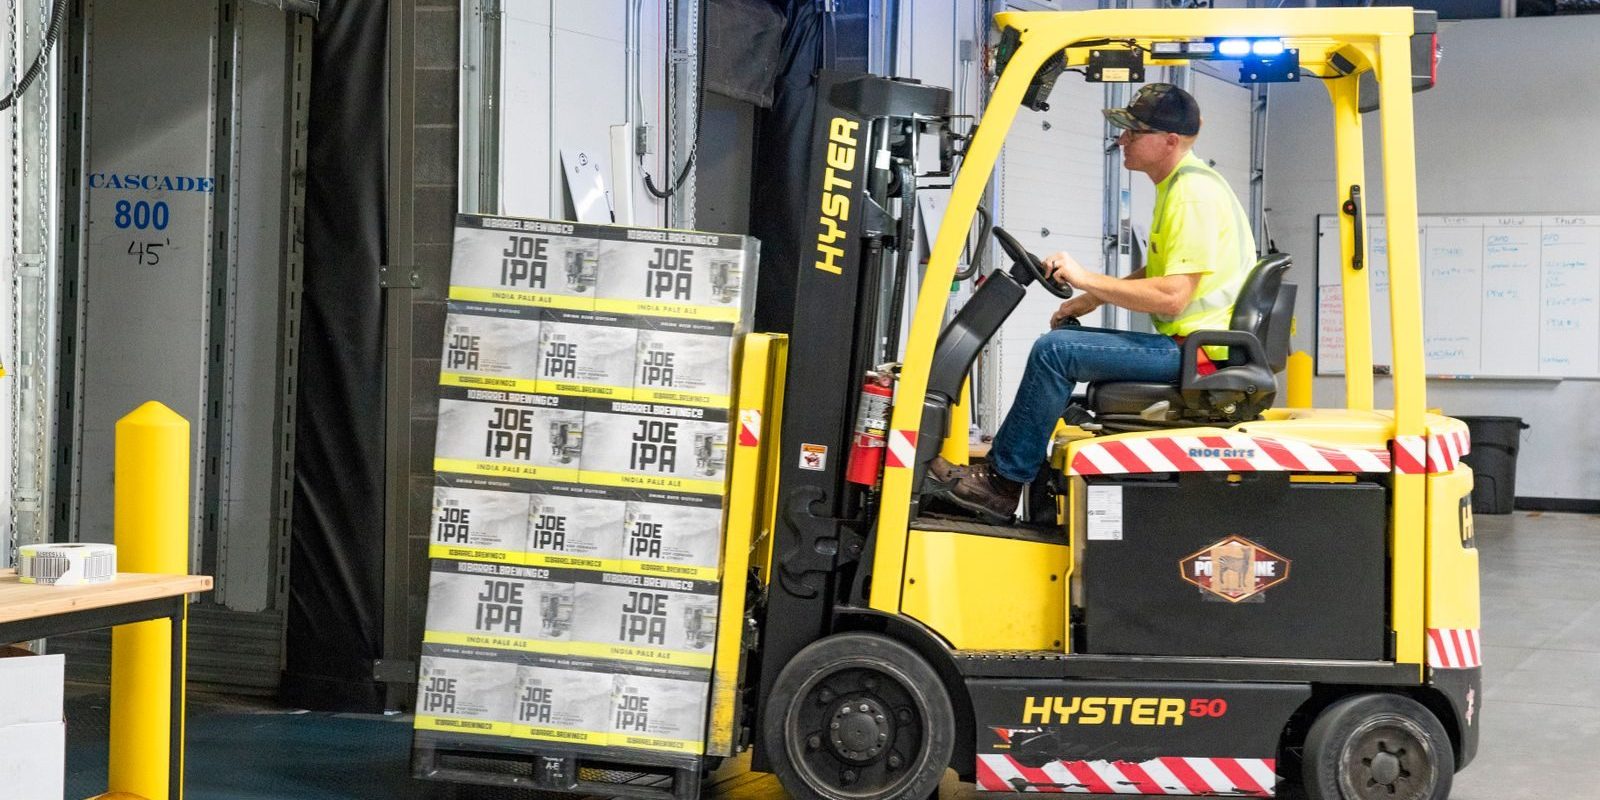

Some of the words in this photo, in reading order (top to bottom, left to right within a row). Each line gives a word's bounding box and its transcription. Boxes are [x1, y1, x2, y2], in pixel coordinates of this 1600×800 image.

[89, 173, 215, 193] CASCADE
[815, 117, 860, 275] HYSTER
[114, 200, 169, 230] 800
[503, 235, 549, 260] JOE
[648, 247, 694, 272] JOE
[500, 258, 548, 289] IPA
[645, 270, 692, 301] IPA
[492, 292, 515, 300] INDIA
[517, 294, 536, 302] PALE
[449, 334, 481, 351] JOE
[546, 342, 578, 359] JOE
[447, 350, 480, 371] IPA
[544, 358, 577, 379] IPA
[643, 350, 675, 367] JOE
[642, 366, 674, 387] IPA
[488, 407, 534, 432] JOE
[633, 419, 679, 444] JOE
[485, 430, 532, 461] IPA
[1189, 448, 1220, 458] RIDE
[630, 442, 677, 473] IPA
[476, 463, 500, 472] INDIA
[502, 465, 520, 474] PALE
[523, 467, 537, 475] ALE
[621, 476, 644, 484] INDIA
[647, 478, 665, 486] PALE
[439, 507, 471, 524] JOE
[535, 514, 566, 532] JOE
[437, 523, 469, 544] IPA
[533, 530, 565, 551] IPA
[631, 522, 663, 539] JOE
[629, 537, 661, 559] IPA
[478, 580, 524, 605] JOE
[623, 591, 668, 616] JOE
[475, 602, 523, 634] IPA
[619, 613, 666, 645] IPA
[466, 636, 489, 644] INDIA
[492, 638, 510, 646] PALE
[513, 640, 527, 648] ALE
[610, 647, 633, 655] INDIA
[636, 650, 654, 658] PALE
[425, 677, 457, 694] JOE
[521, 686, 553, 704] JOE
[424, 692, 456, 714] IPA
[519, 702, 551, 723] IPA
[618, 695, 649, 712] JOE
[1022, 696, 1186, 726] HYSTER
[1188, 698, 1228, 718] 50
[616, 710, 648, 732] IPA
